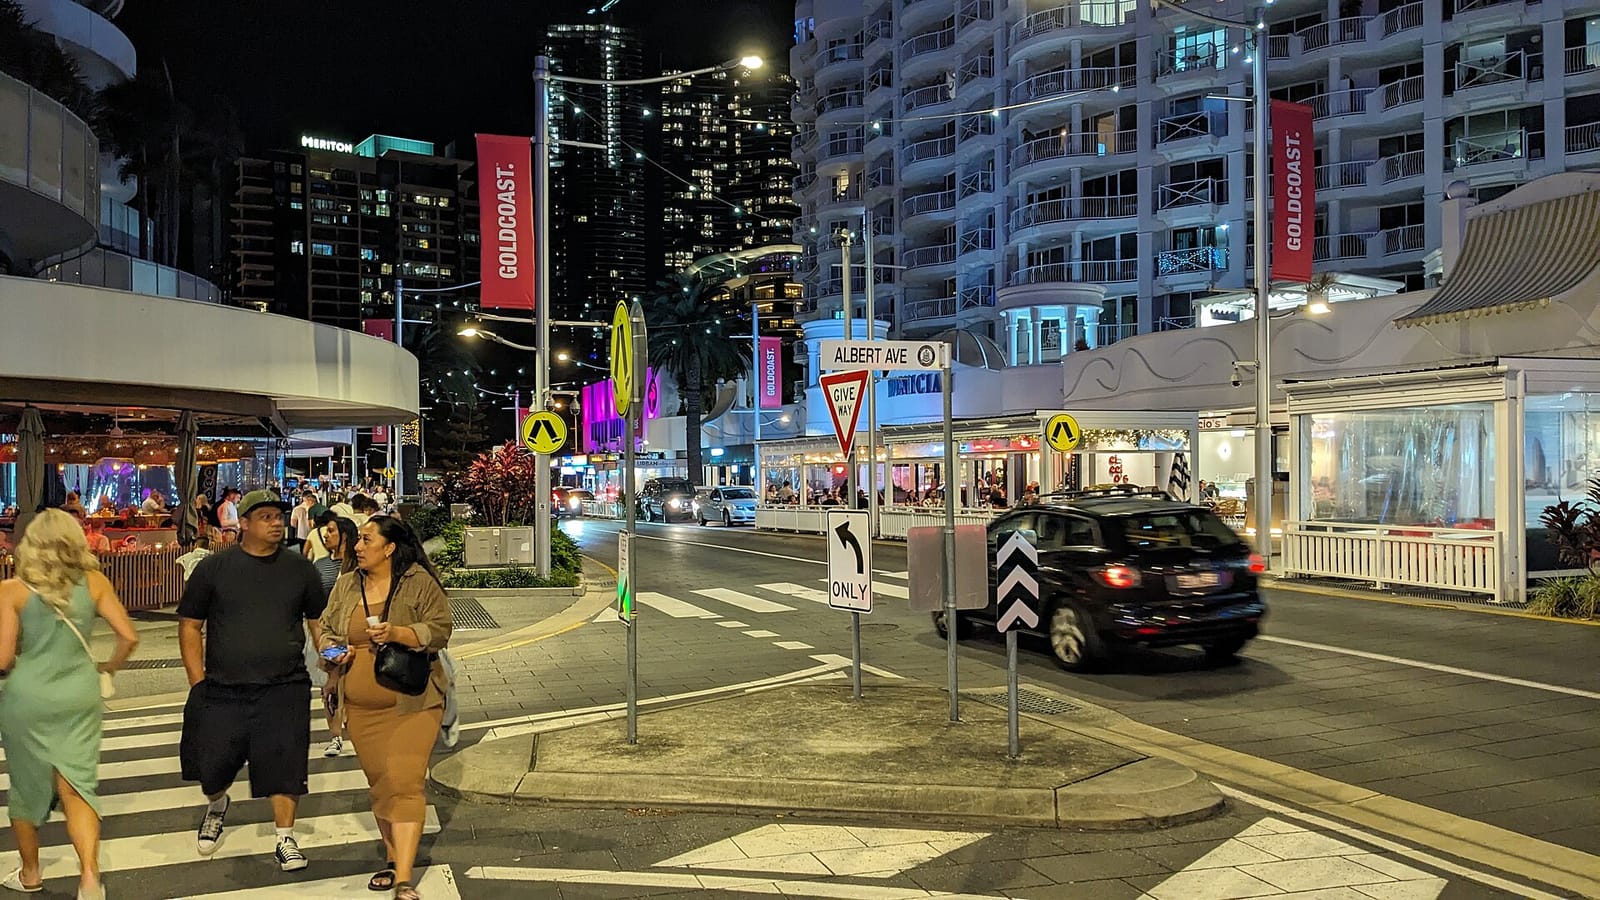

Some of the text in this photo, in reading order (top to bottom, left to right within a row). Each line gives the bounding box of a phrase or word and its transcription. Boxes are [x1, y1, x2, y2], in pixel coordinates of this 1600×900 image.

[301, 135, 353, 154] MERITON
[834, 347, 882, 363] ALBERT
[884, 348, 908, 364] AVE
[833, 386, 855, 402] GIVE
[838, 404, 852, 416] WAY
[832, 581, 867, 601] ONLY
